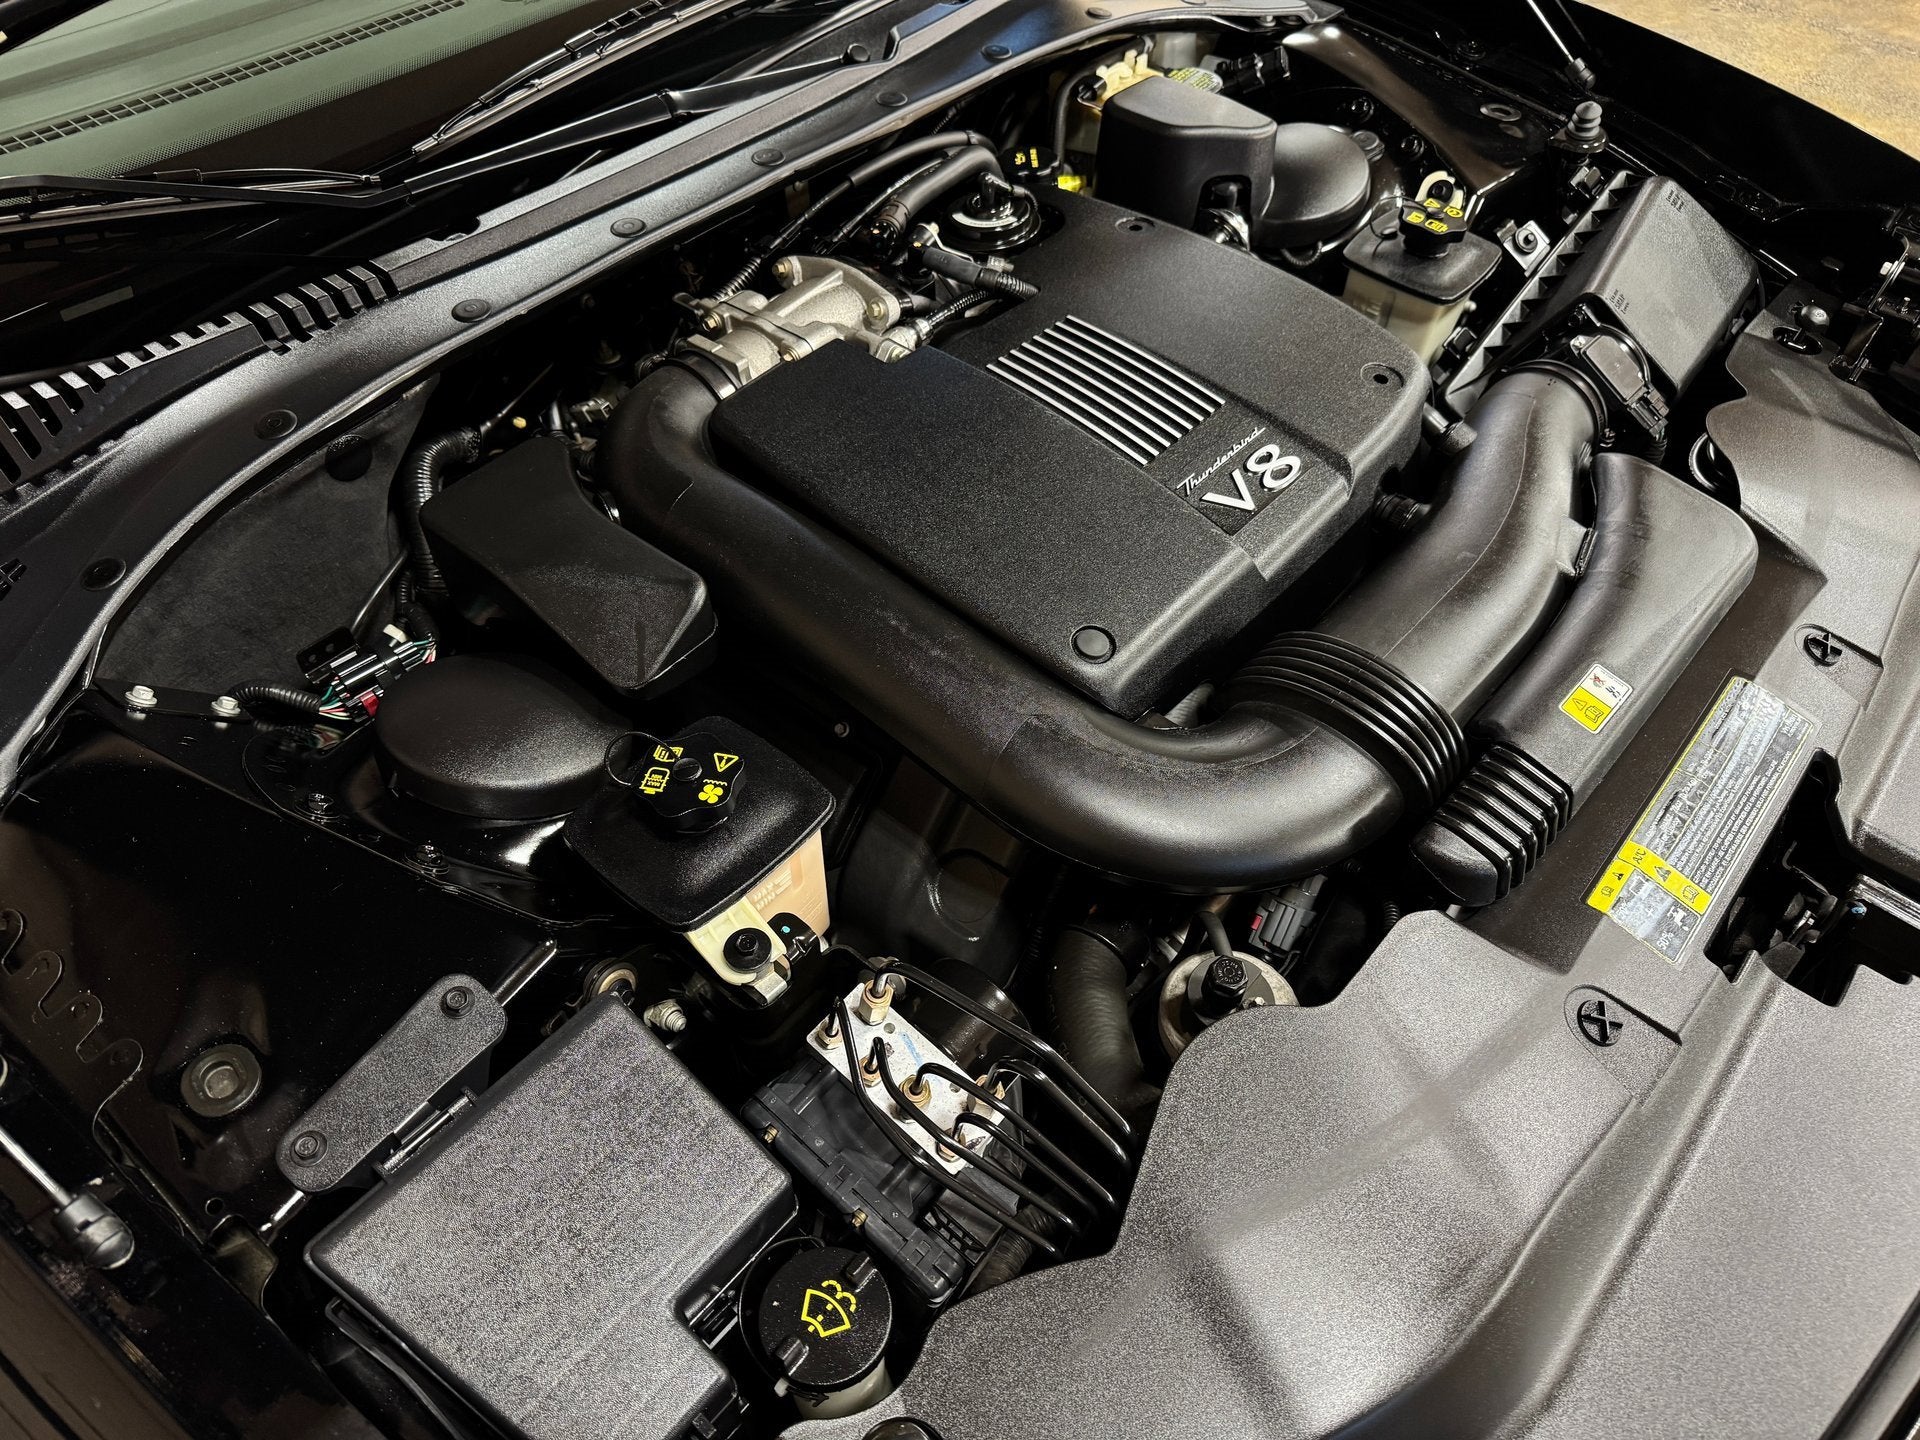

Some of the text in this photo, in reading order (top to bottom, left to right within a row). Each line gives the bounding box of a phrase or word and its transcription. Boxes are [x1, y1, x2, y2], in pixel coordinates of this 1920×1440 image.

[1176, 427, 1266, 495] Thunderbird
[1201, 443, 1301, 511] V8
[1632, 848, 1646, 865] A/C
